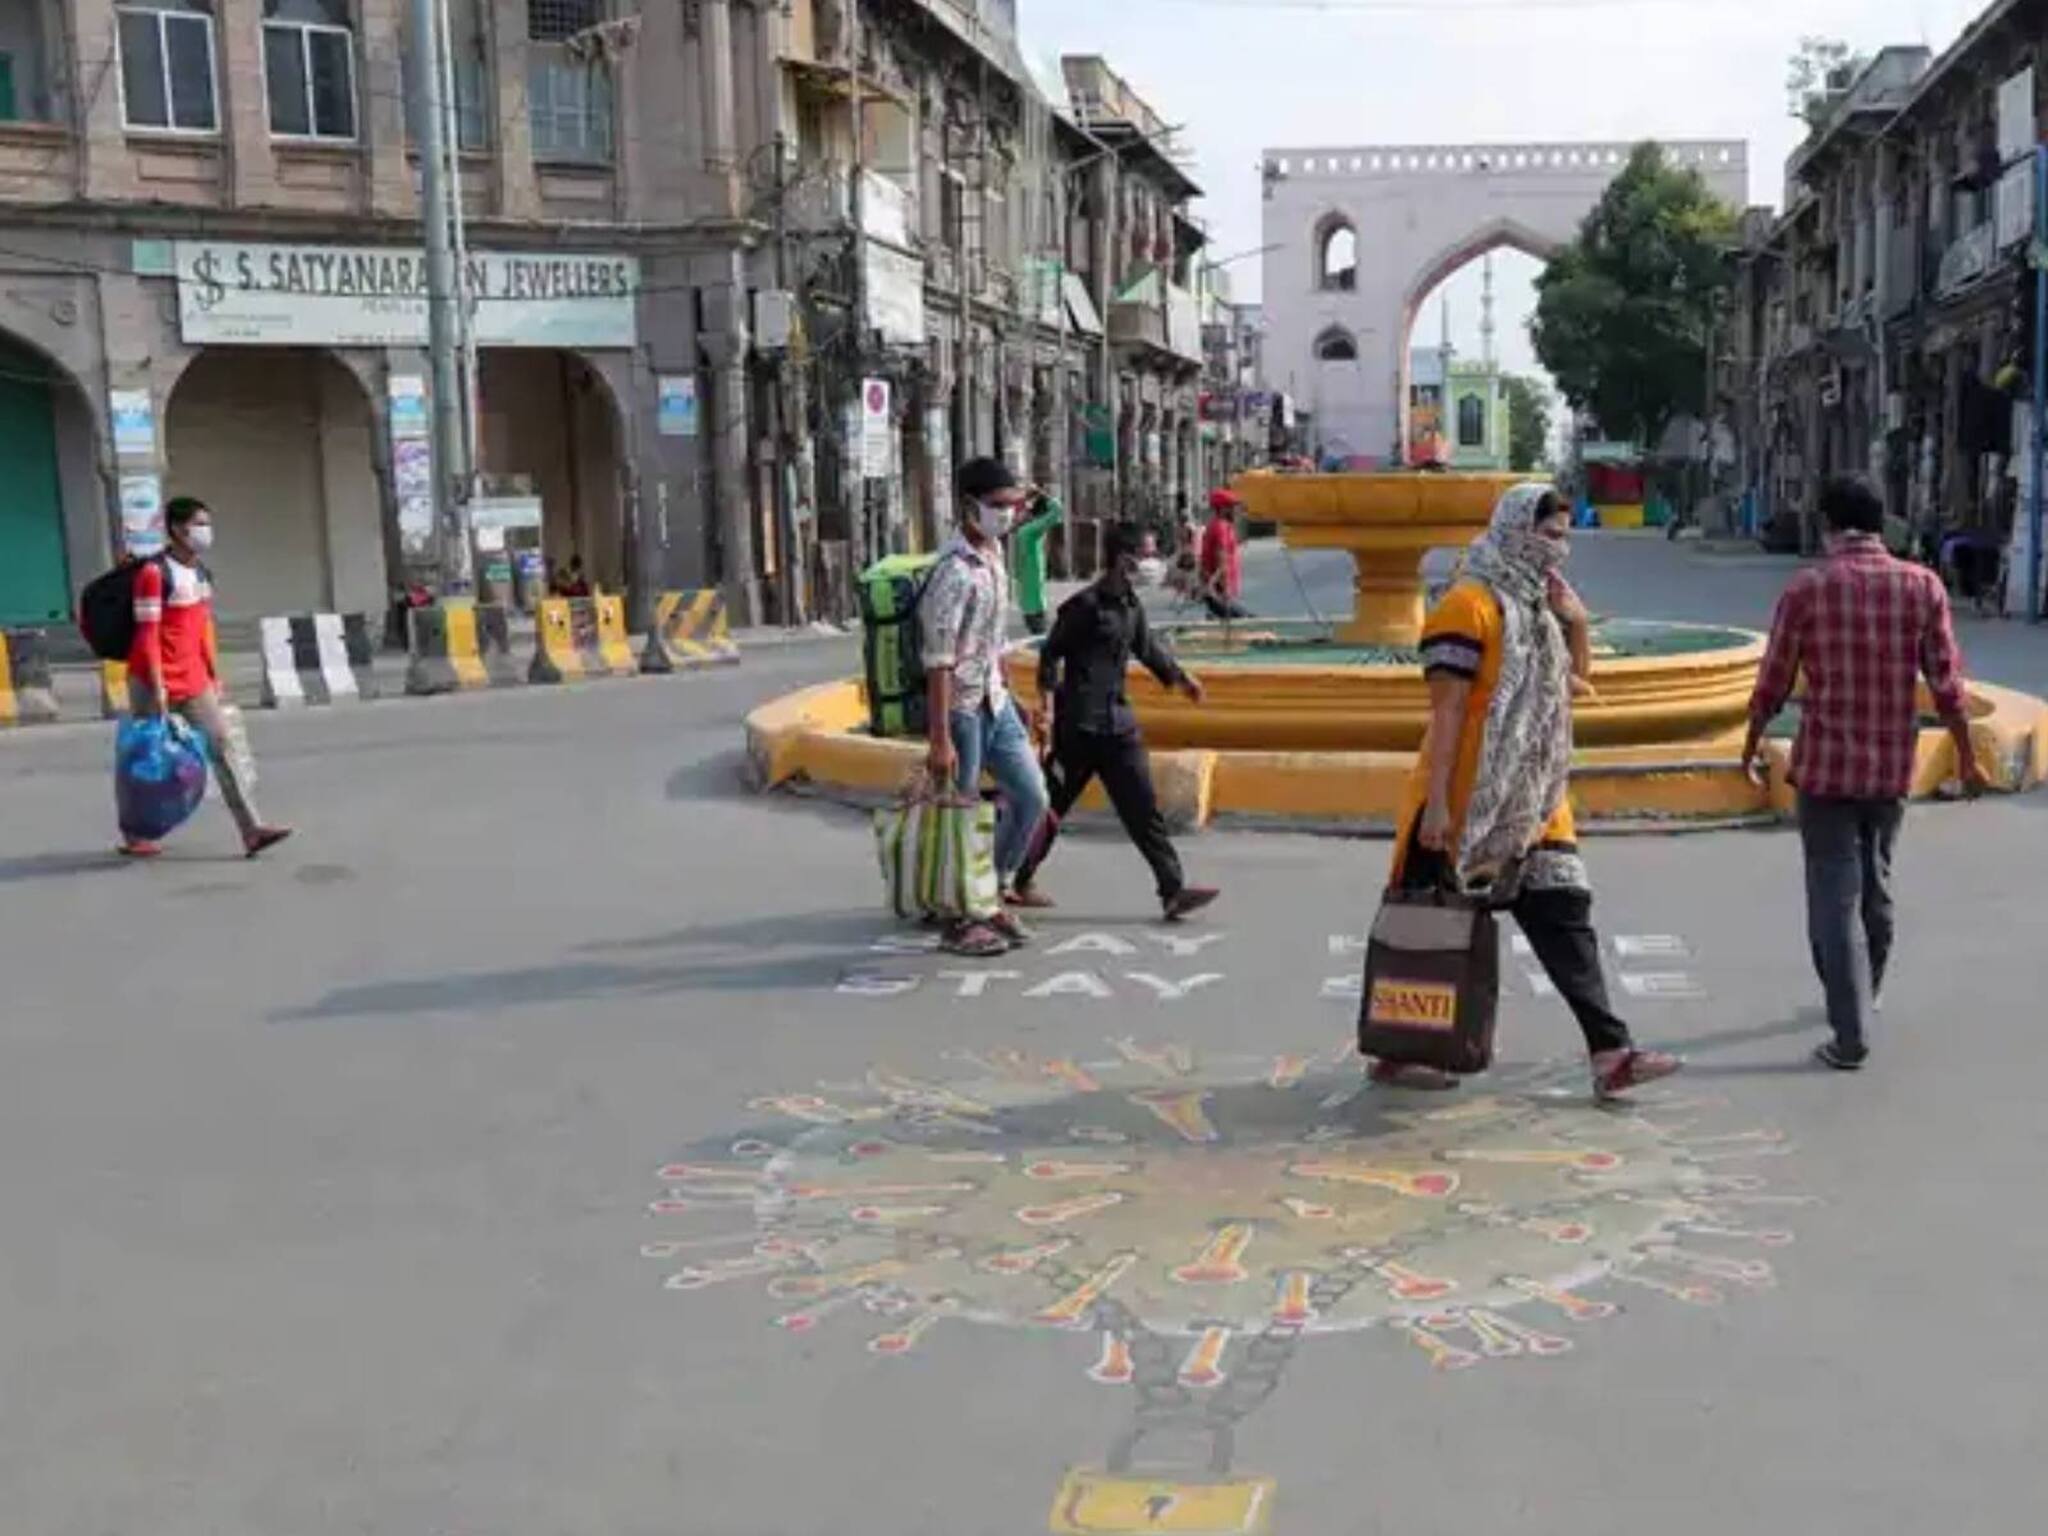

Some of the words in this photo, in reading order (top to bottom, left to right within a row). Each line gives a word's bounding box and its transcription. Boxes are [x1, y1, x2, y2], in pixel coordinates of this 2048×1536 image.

[237, 251, 262, 291] S.
[270, 252, 487, 297] SATYANARAN
[503, 258, 628, 299] JEWELLERS
[867, 931, 1228, 955] SAY
[834, 970, 1227, 997] STAY
